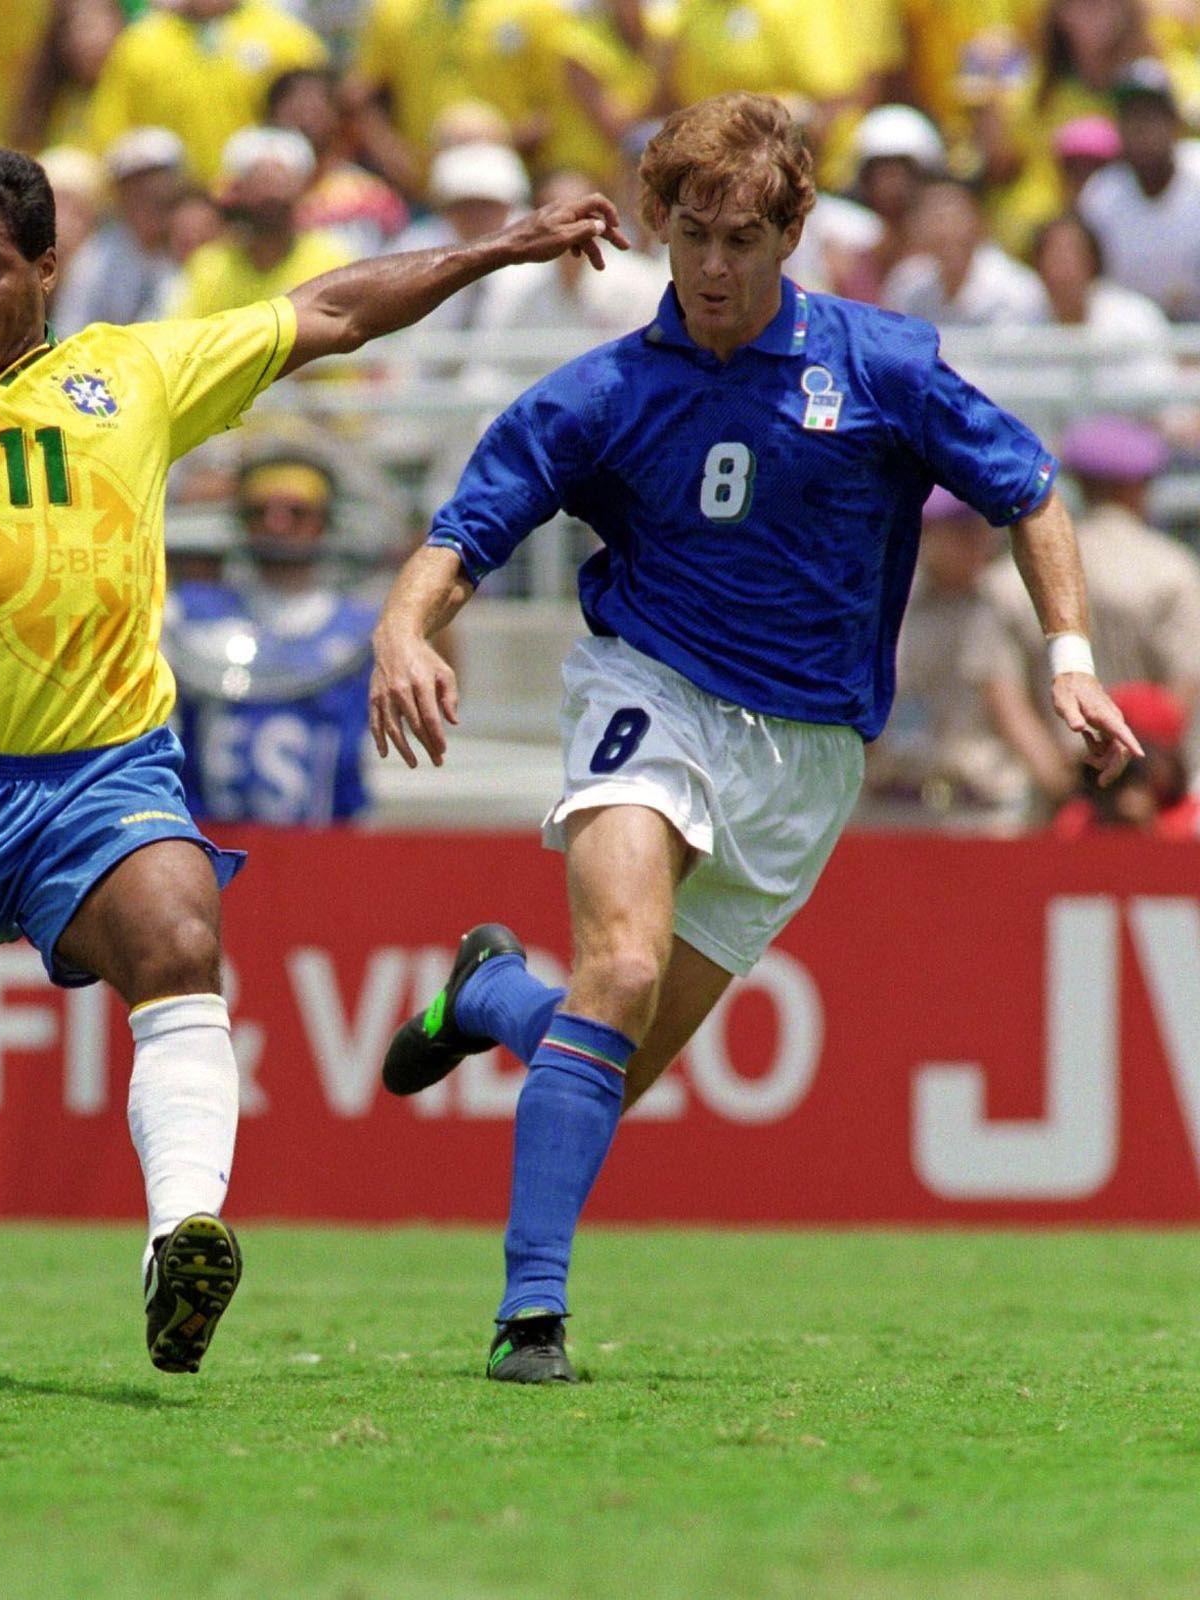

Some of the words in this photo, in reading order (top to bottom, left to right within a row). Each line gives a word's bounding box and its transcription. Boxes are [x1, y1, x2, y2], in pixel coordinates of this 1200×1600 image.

[701, 442, 757, 523] 8
[48, 548, 108, 574] CBF
[589, 707, 651, 775] 8
[287, 946, 824, 1125] VIDO
